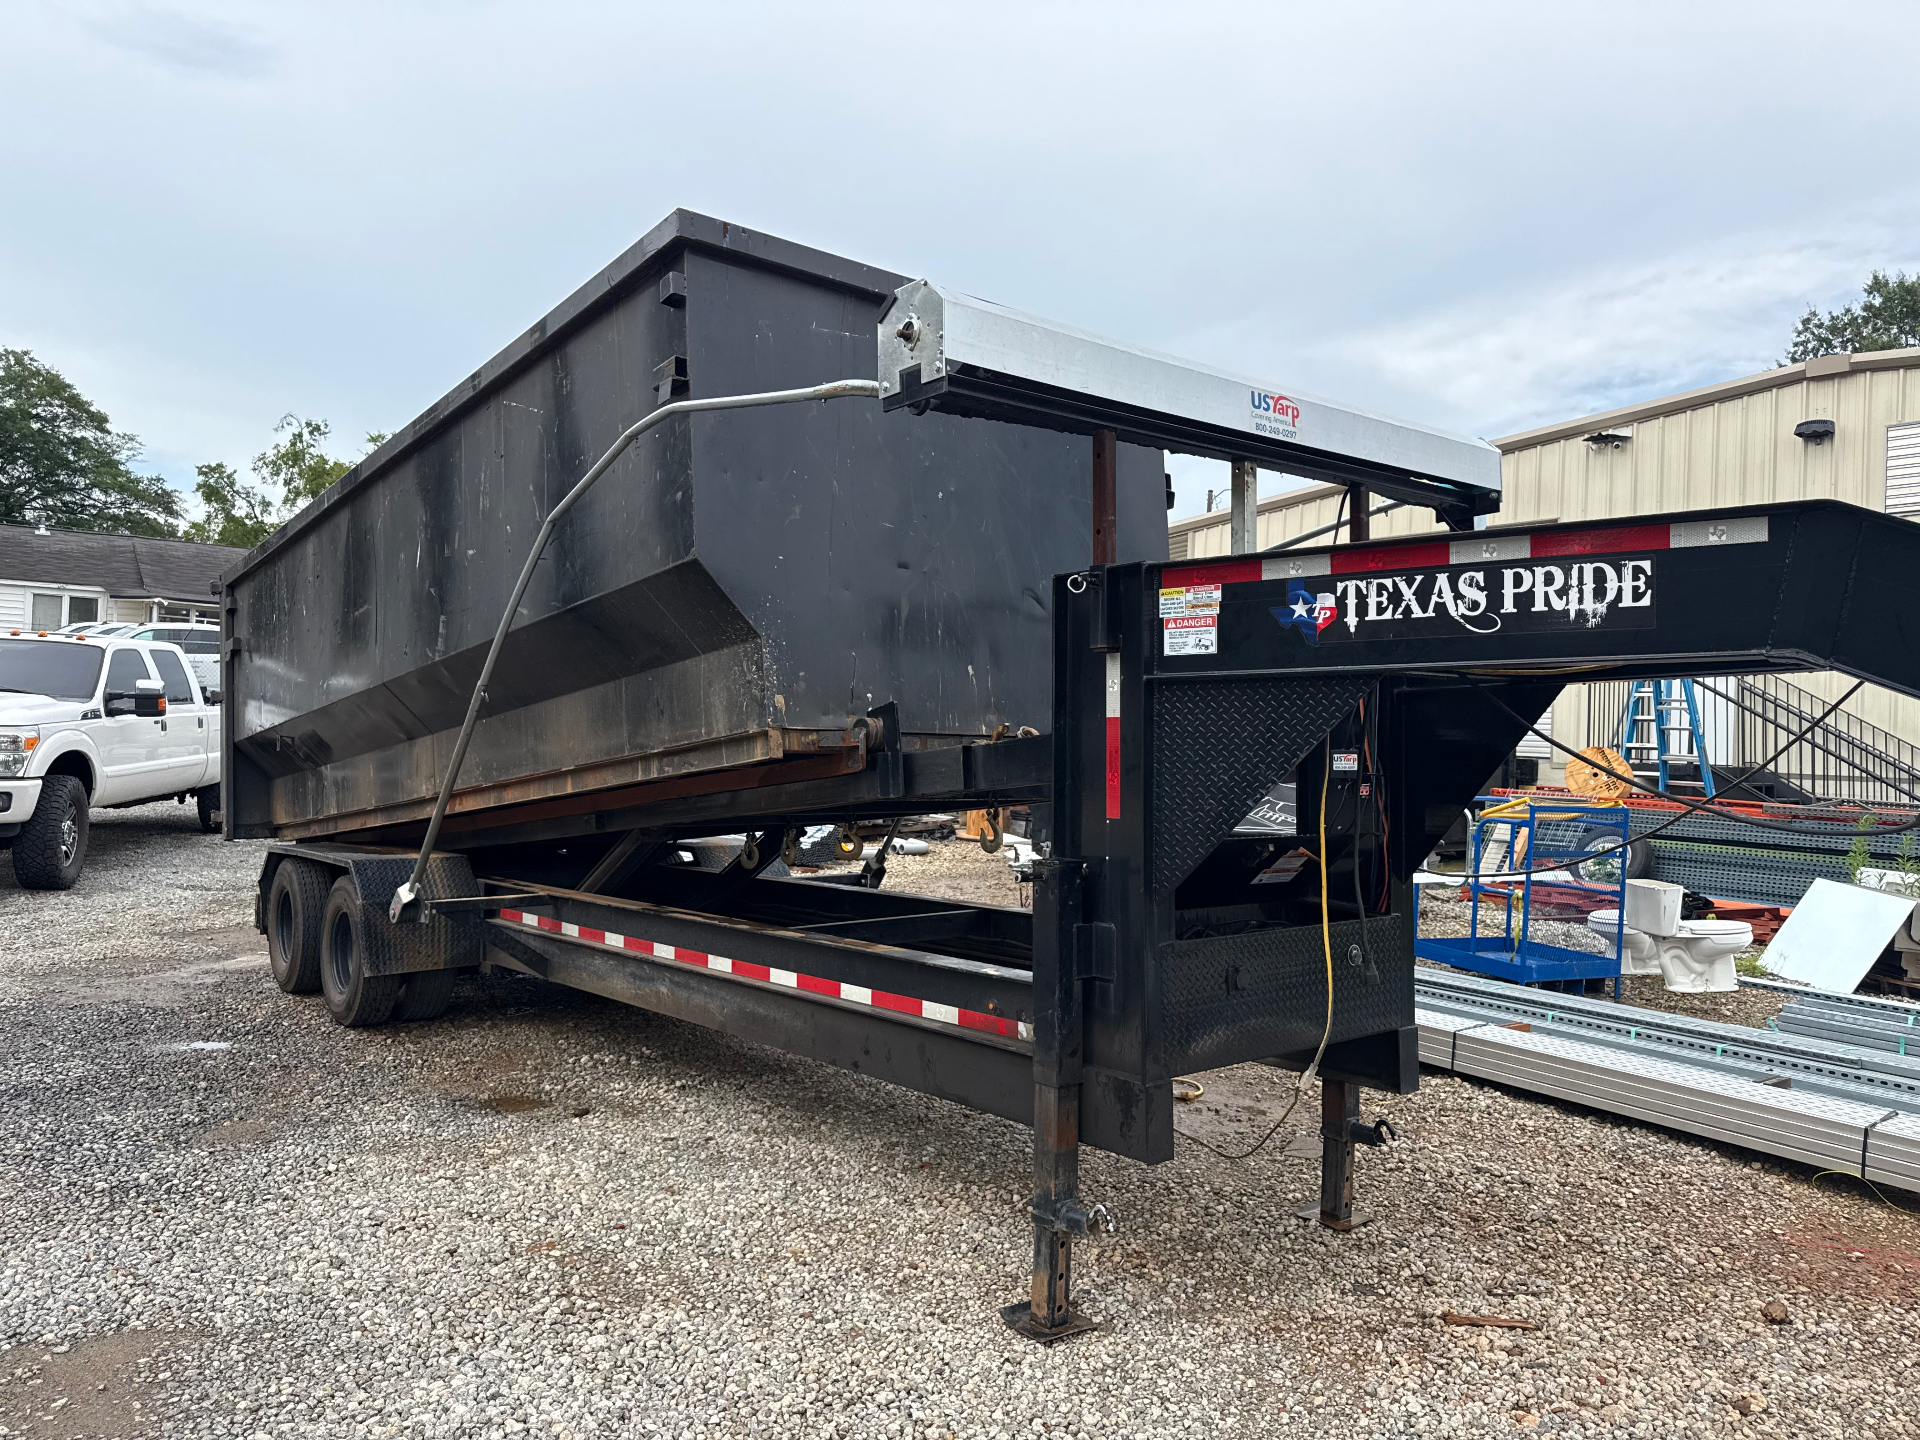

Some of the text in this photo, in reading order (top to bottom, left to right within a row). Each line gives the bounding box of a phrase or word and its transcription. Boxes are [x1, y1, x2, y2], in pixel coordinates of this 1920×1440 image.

[1273, 416, 1291, 427] America
[1336, 560, 1652, 634] TEXAS PRIDE
[1176, 617, 1213, 627] DANGER
